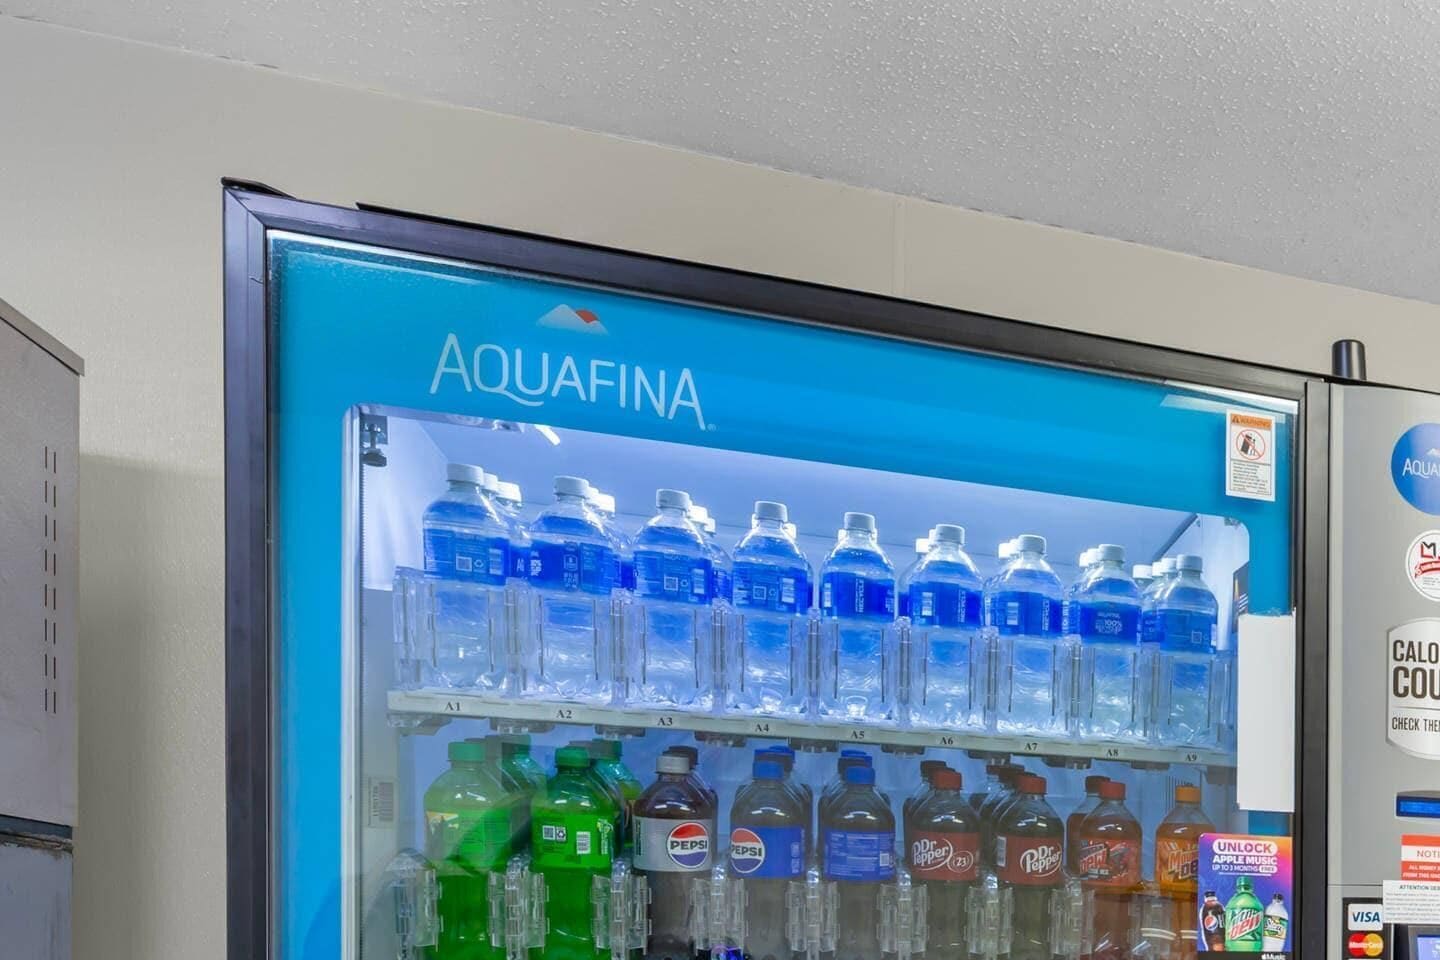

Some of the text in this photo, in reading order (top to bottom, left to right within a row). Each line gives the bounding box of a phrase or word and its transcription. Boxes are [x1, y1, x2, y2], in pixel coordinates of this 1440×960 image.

[429, 332, 707, 431] AQUAFINA
[1391, 716, 1420, 733] CHECK
[445, 701, 1197, 763] A1 A2 A3 A4 A5 A6 A7 A8 A9
[669, 839, 708, 851] PEPSI
[731, 844, 763, 857] PEPSI
[921, 838, 937, 851] Dr
[1038, 845, 1054, 857] Dr
[1217, 841, 1272, 853] UNLOCK
[912, 841, 949, 866] Pepper
[1213, 855, 1278, 865] APPLE MUSIC
[956, 856, 967, 867] 23
[1025, 849, 1061, 873] Pepper
[1352, 911, 1381, 923] VISA
